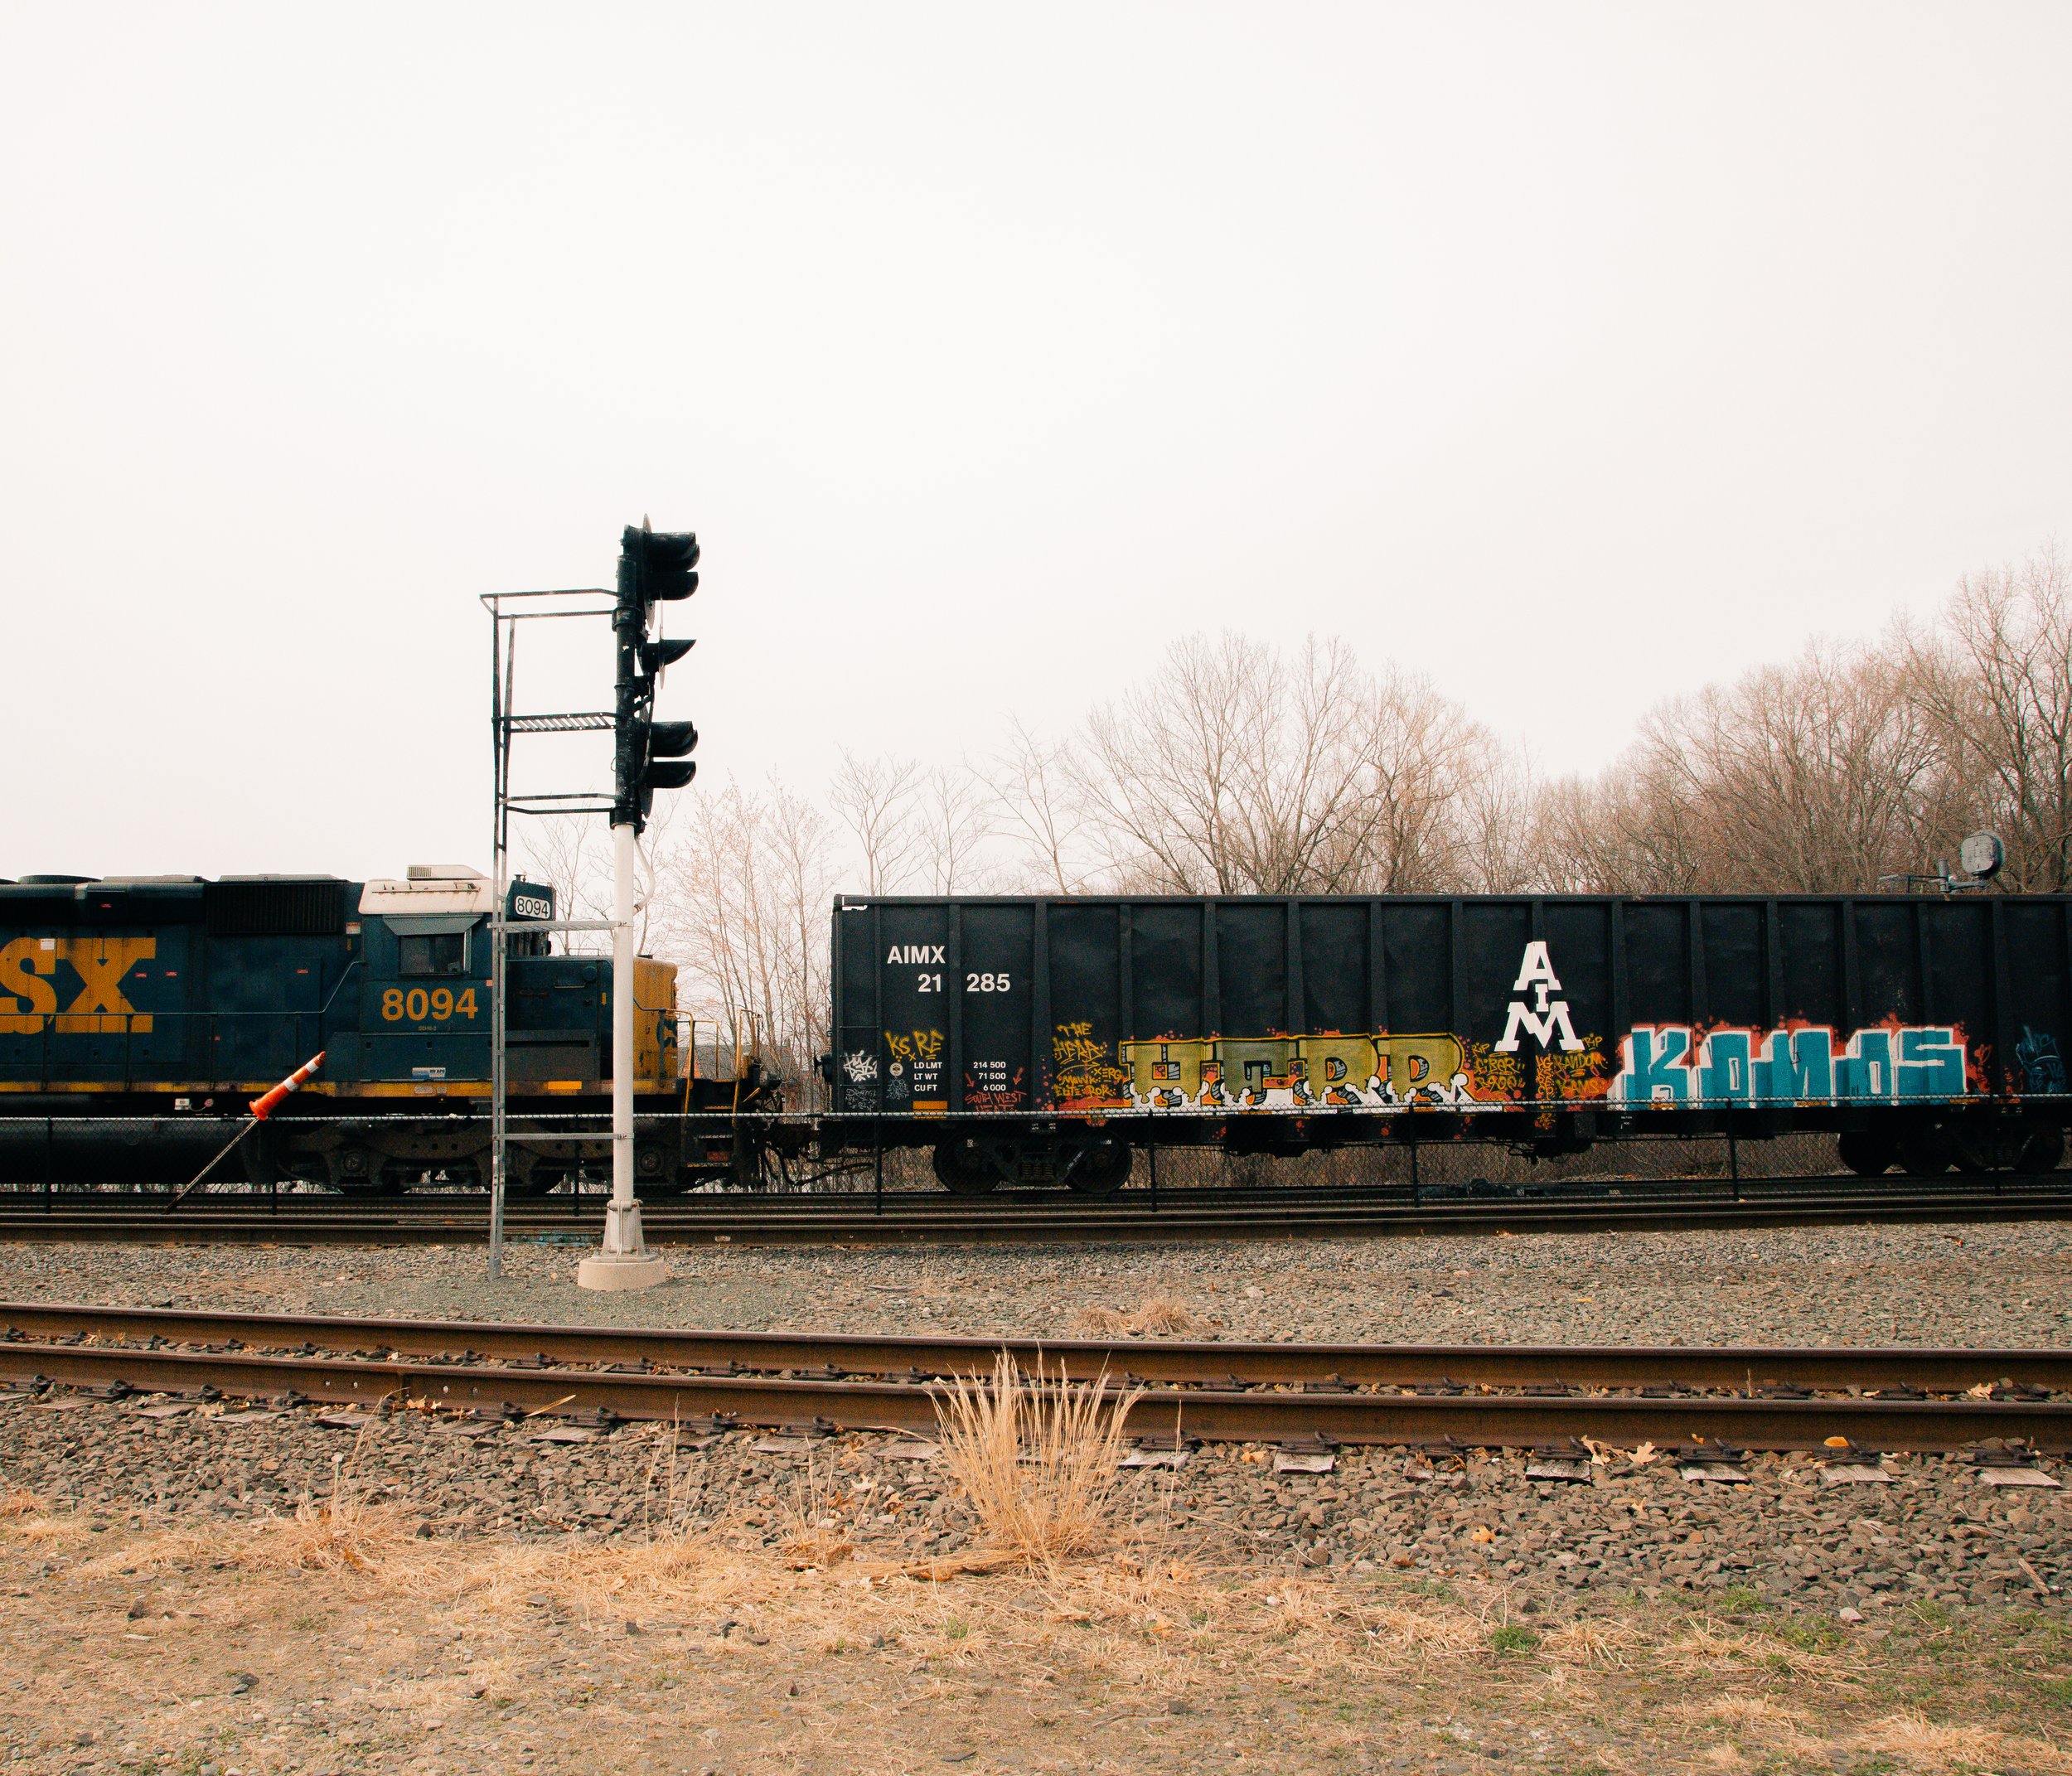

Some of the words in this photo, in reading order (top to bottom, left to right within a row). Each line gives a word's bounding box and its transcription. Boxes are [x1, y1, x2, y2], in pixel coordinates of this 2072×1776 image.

[517, 898, 549, 917] 8094
[887, 946, 946, 964] AIMX
[917, 974, 942, 992] 21
[966, 973, 1011, 992] 285
[382, 988, 478, 1021] 8094
